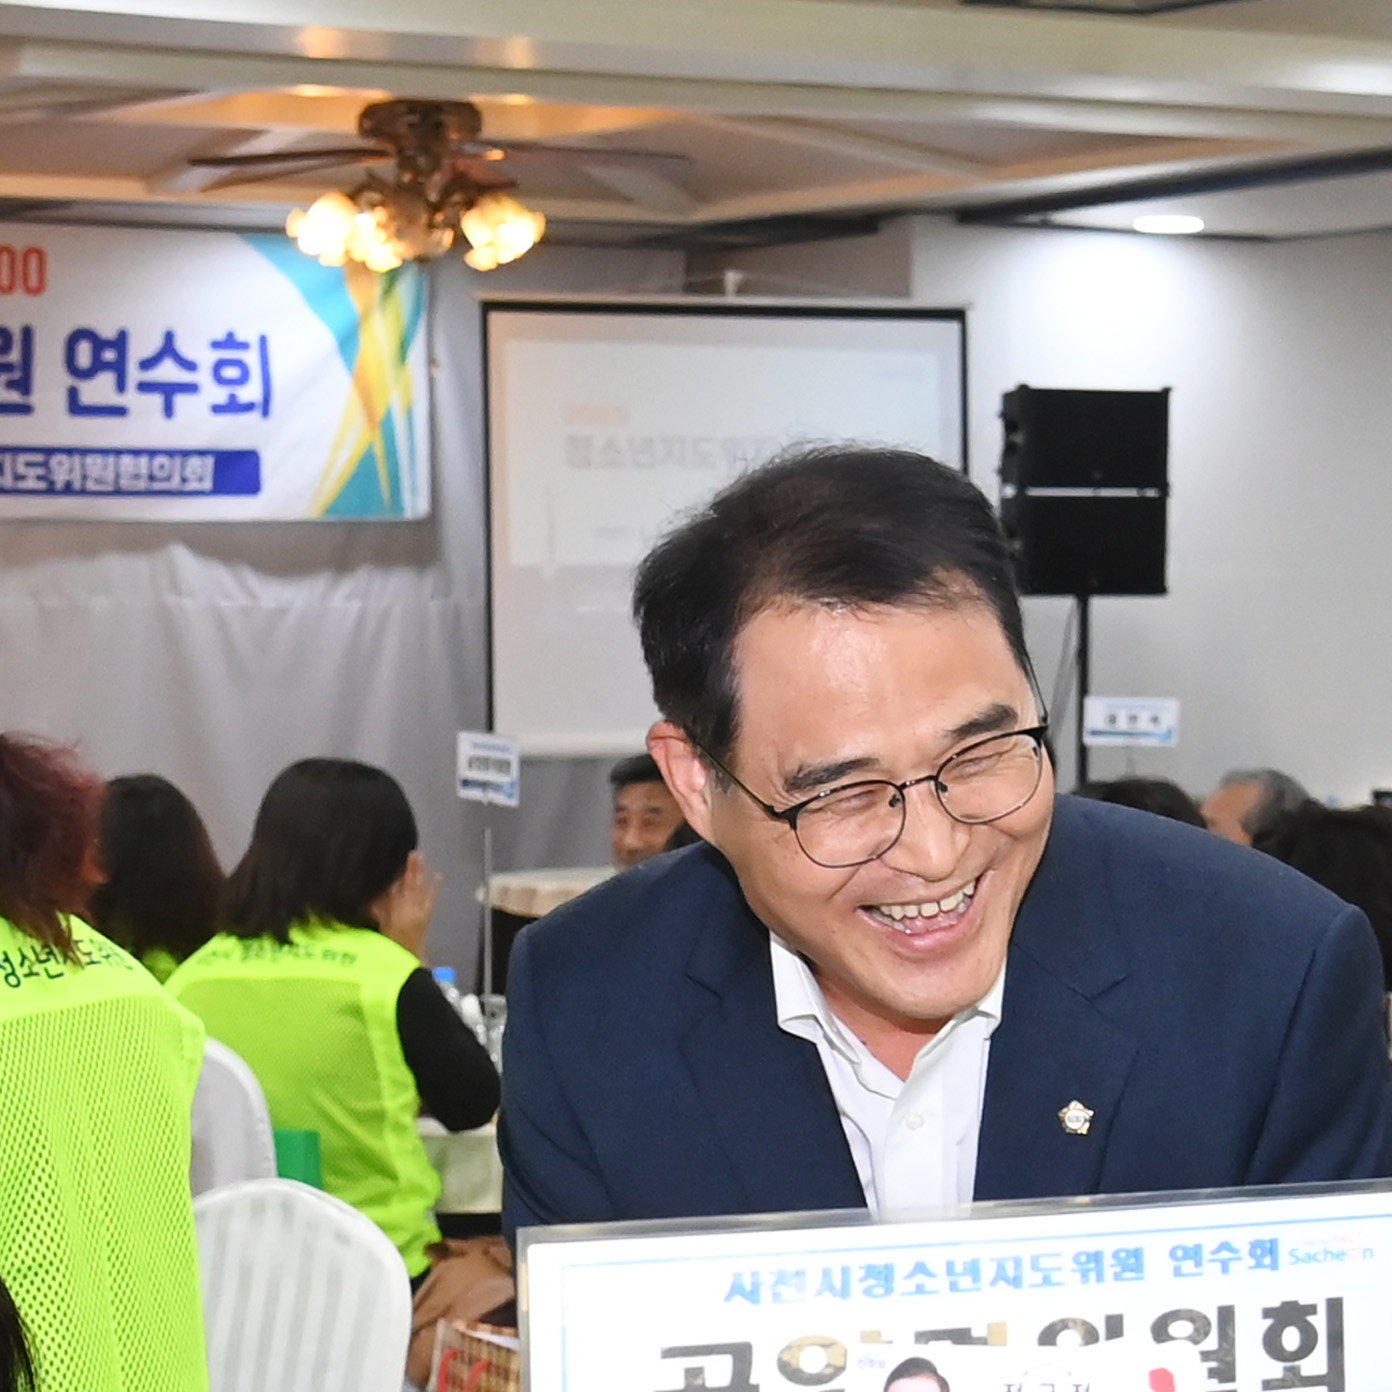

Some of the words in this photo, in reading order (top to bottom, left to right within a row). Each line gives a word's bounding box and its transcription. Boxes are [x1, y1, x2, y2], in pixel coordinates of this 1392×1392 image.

[63, 325, 275, 420] 연수회
[723, 1247, 1146, 1305] 사천시청소년지도위원
[1168, 1237, 1280, 1278] 연수회
